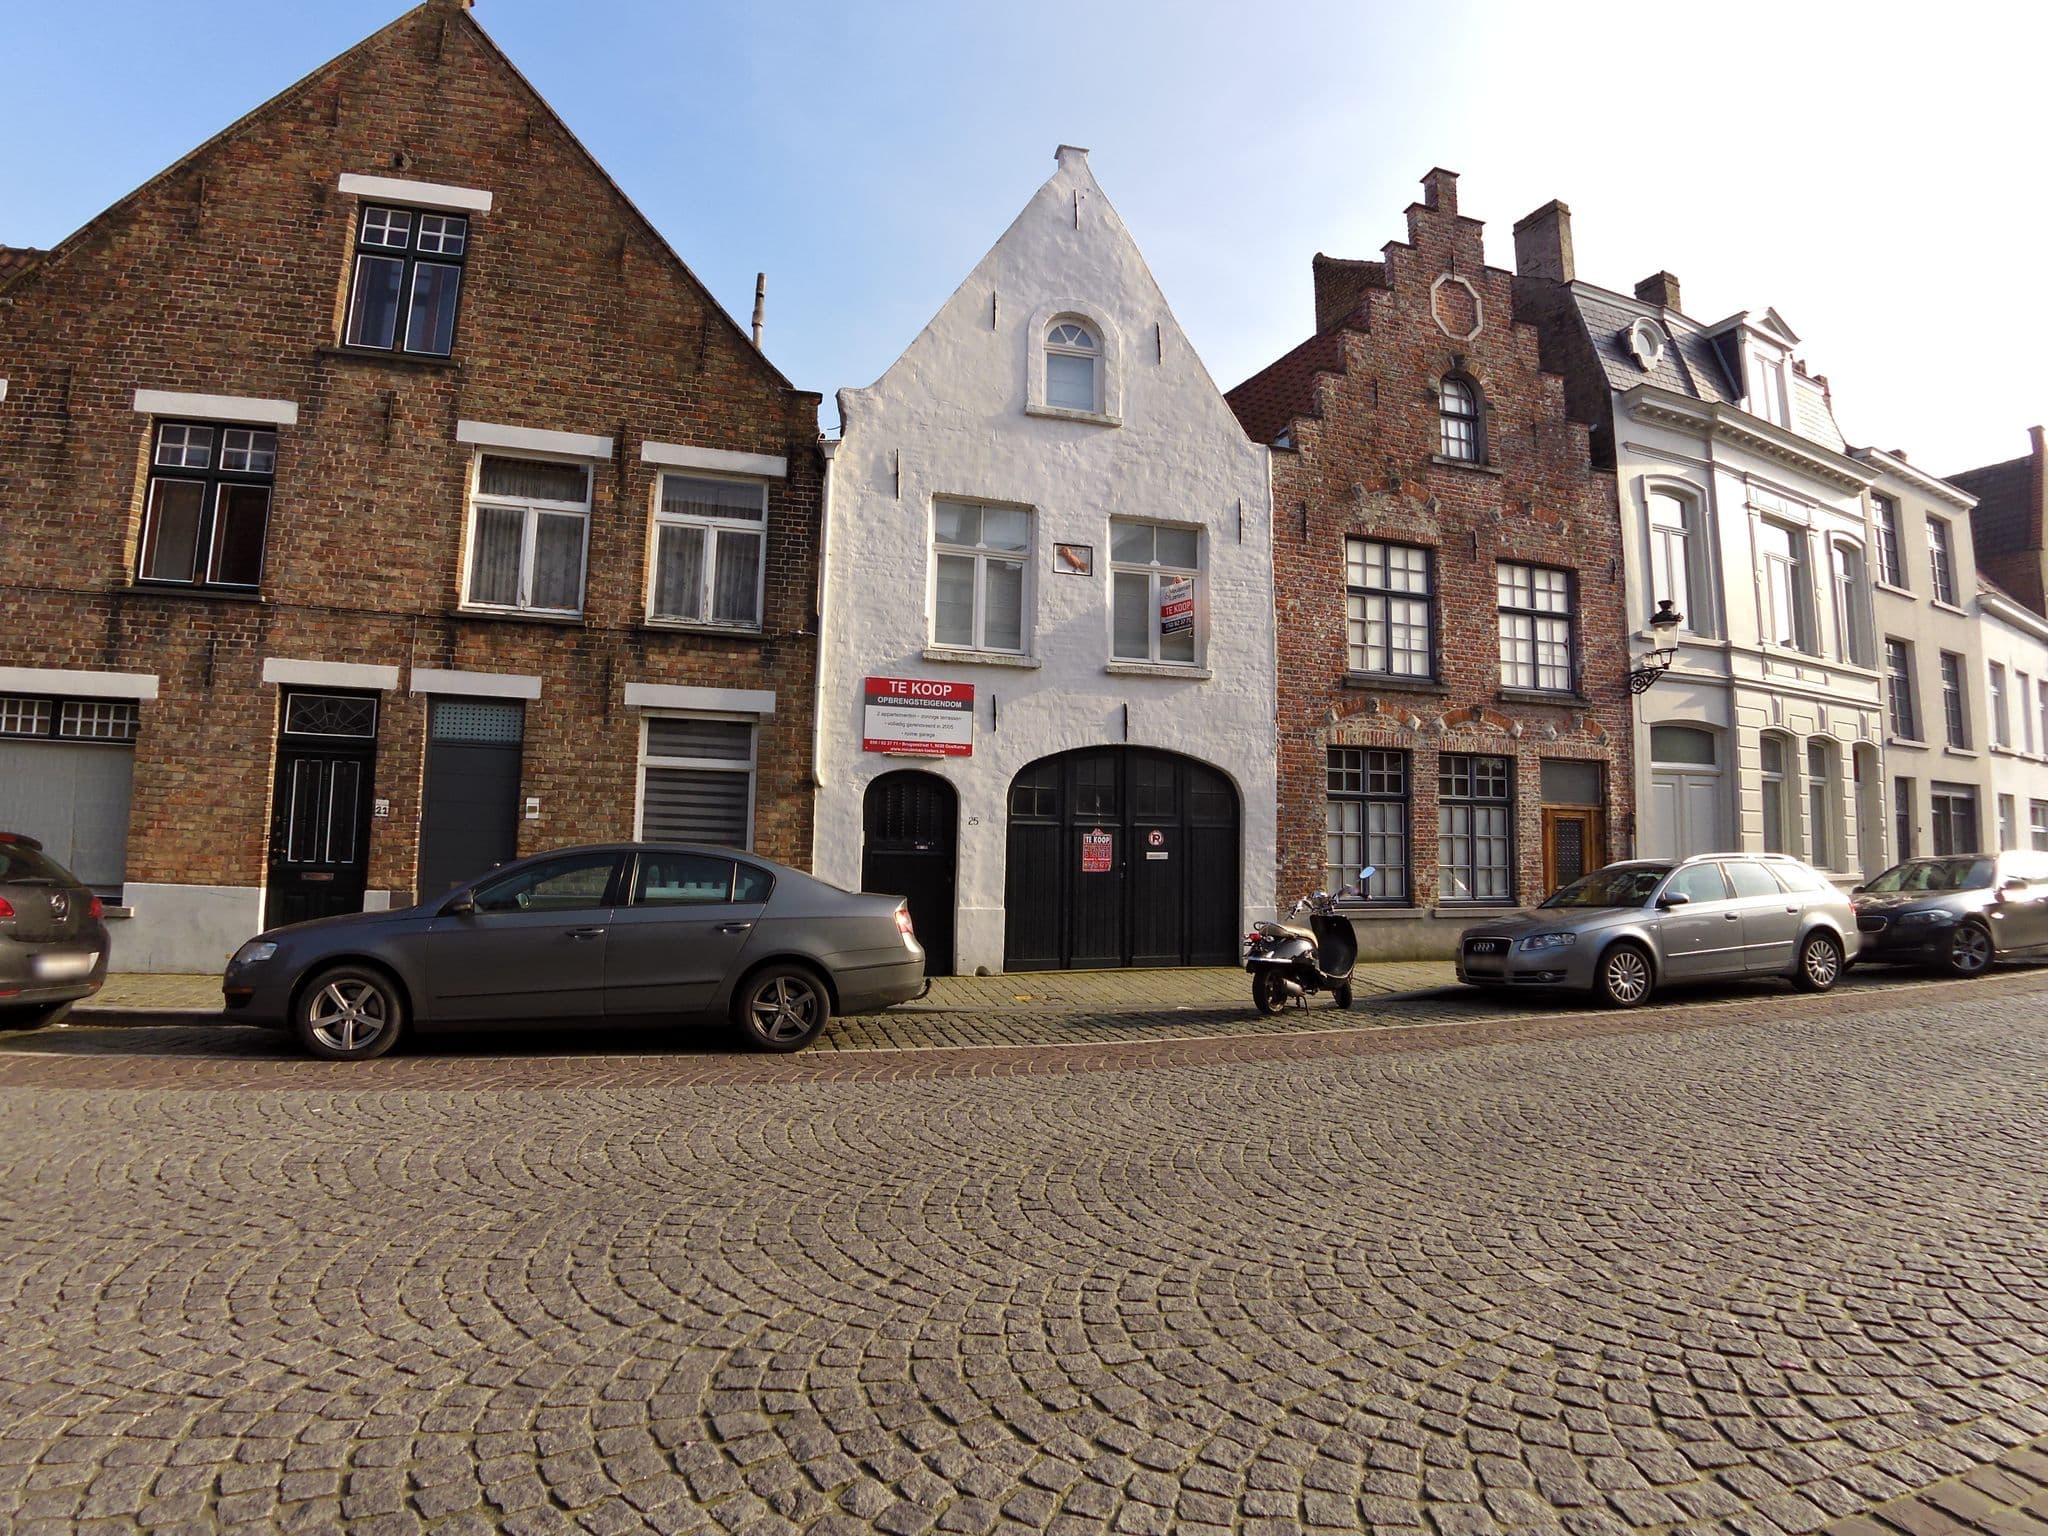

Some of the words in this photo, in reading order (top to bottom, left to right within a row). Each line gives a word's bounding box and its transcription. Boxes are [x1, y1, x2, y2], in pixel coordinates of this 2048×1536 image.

[1166, 606, 1174, 616] TE
[1173, 600, 1192, 614] KOOP
[888, 680, 907, 694] TE
[911, 682, 953, 697] KOOP
[877, 696, 962, 708] OPBRENGSTEIGENDOM
[375, 806, 387, 815] 21
[967, 816, 979, 826] 25
[1086, 836, 1092, 844] TE
[1093, 836, 1110, 844] KOOP
